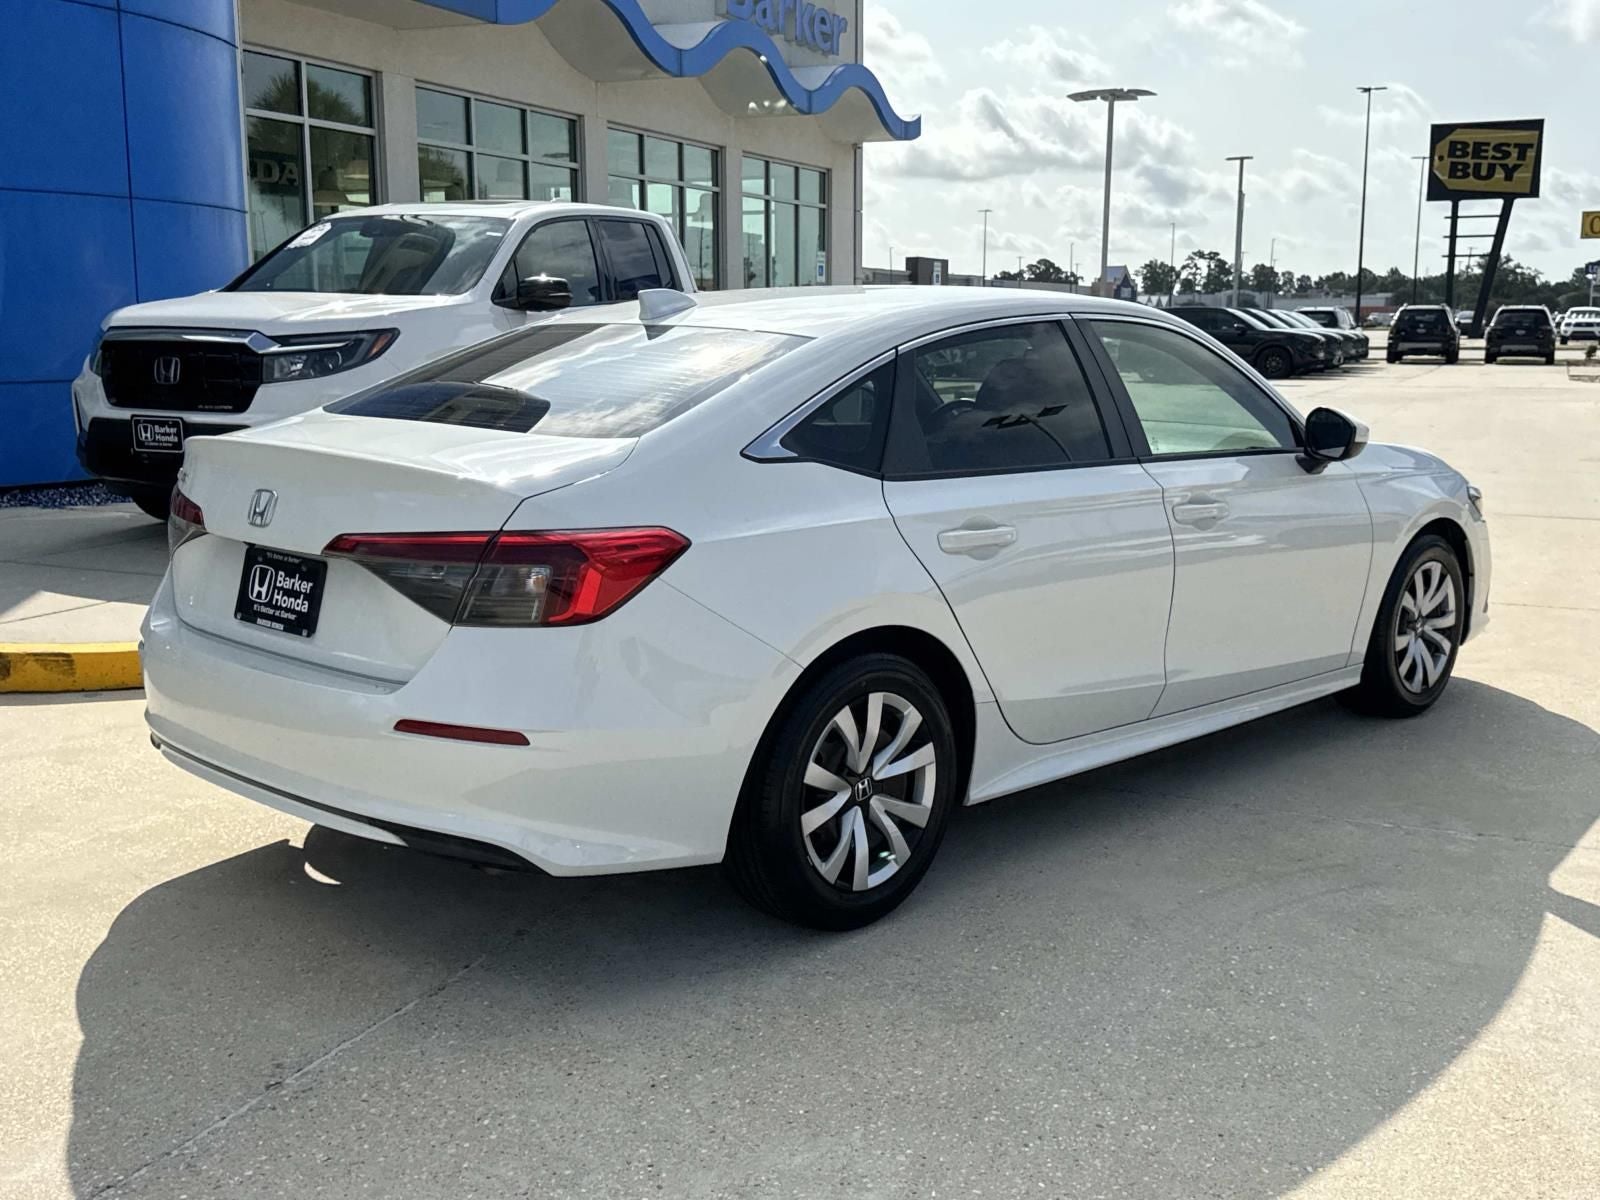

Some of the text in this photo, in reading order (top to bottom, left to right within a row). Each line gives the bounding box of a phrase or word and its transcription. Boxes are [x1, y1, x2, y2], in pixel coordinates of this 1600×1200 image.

[1448, 140, 1534, 161] BEST
[1448, 161, 1523, 182] BUY
[154, 424, 177, 433] Barker
[155, 433, 178, 442] Honda
[276, 570, 314, 594] Barker
[272, 589, 309, 613] Honda
